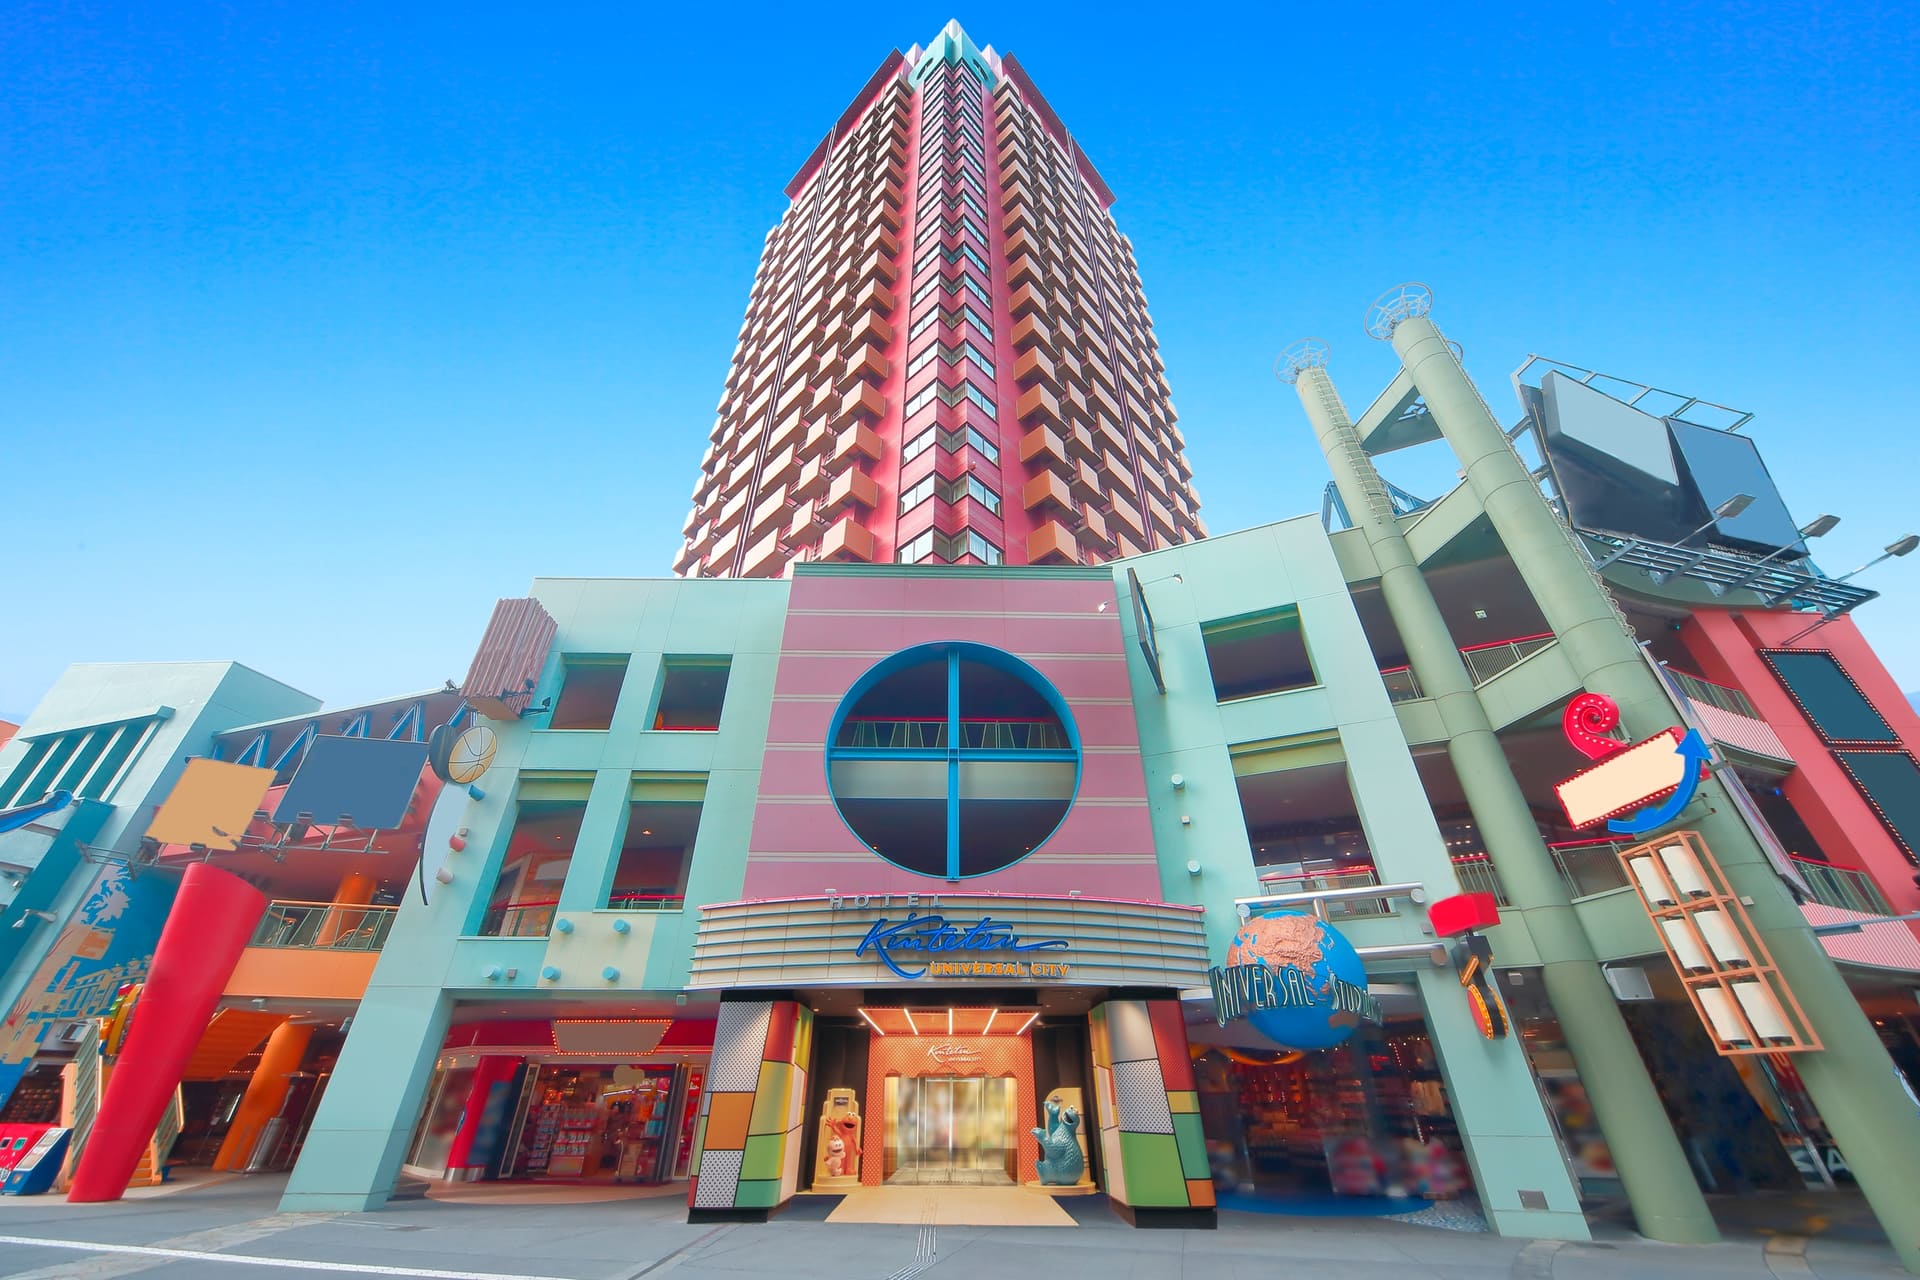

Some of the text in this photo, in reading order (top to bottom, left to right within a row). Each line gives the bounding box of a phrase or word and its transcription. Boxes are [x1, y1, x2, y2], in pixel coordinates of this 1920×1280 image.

[829, 892, 944, 910] HOTEL
[855, 912, 1069, 980] Kintetsu
[929, 961, 1070, 976] UNIVERSAL CITY
[1330, 972, 1384, 1027] STUD
